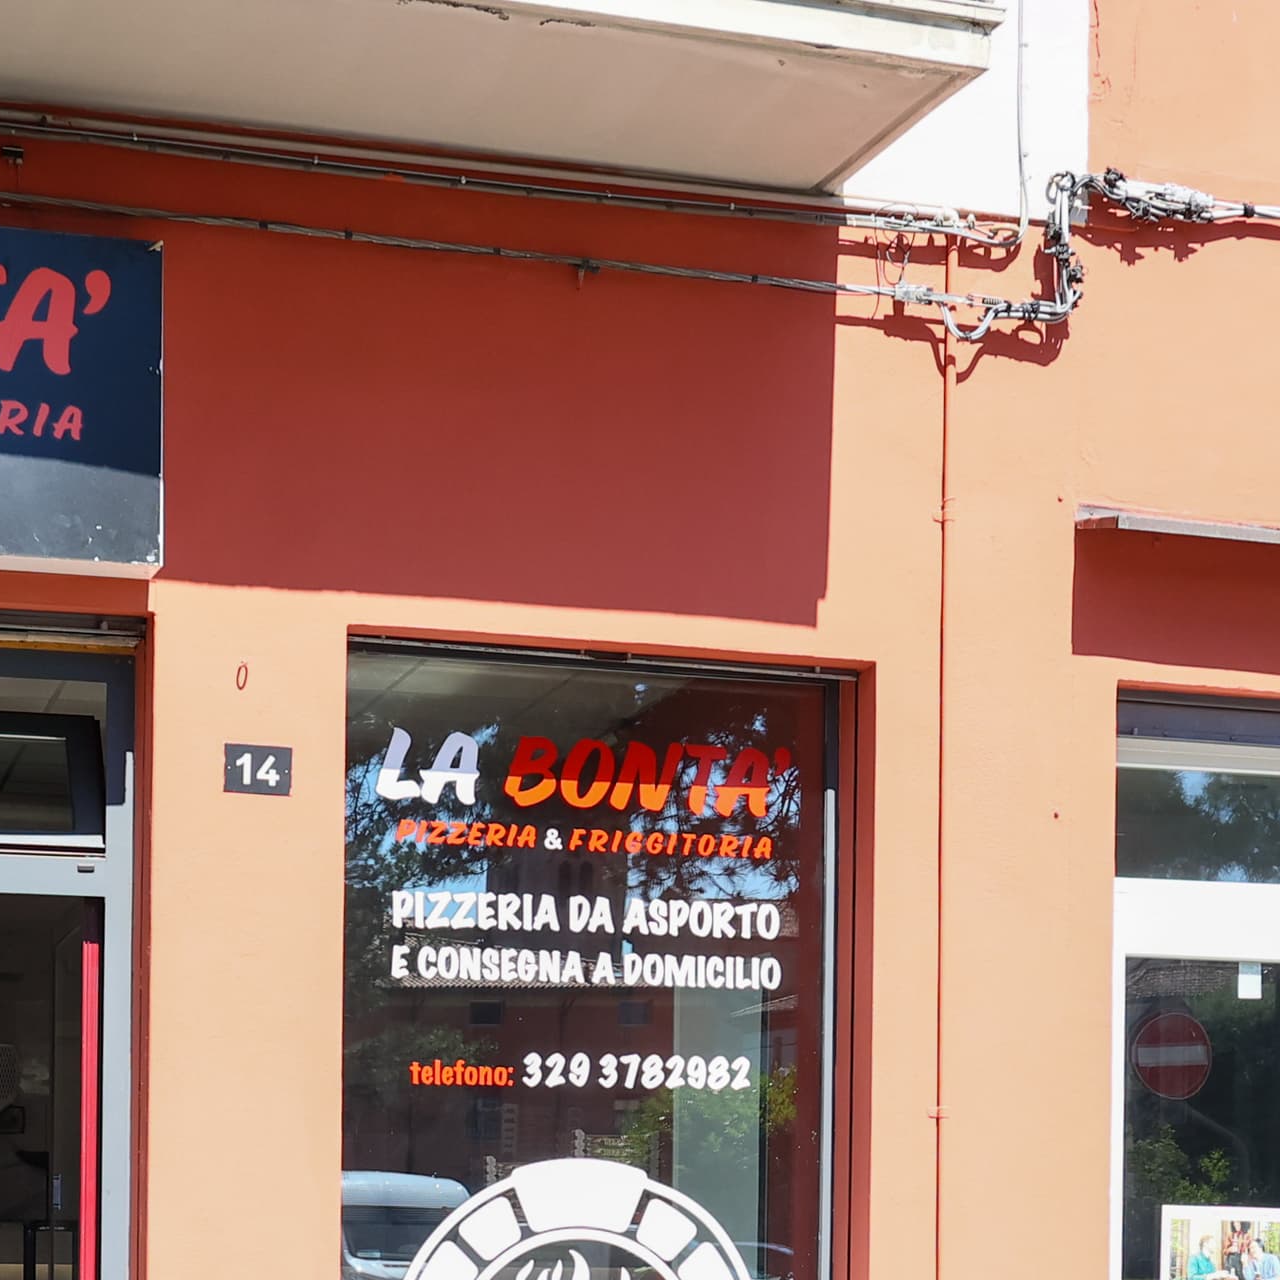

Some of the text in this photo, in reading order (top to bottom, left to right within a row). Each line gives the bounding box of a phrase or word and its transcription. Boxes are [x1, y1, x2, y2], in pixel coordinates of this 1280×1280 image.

[236, 753, 280, 787] 14
[376, 727, 479, 805] LA
[396, 819, 773, 860] PIZZERIA & FRIGGITORIA
[392, 891, 780, 940] PIZZERIA DA ASPORTO
[391, 945, 781, 990] E CONSEGNA A DOMICILIO
[410, 1052, 751, 1090] telefono: 329 3782982
